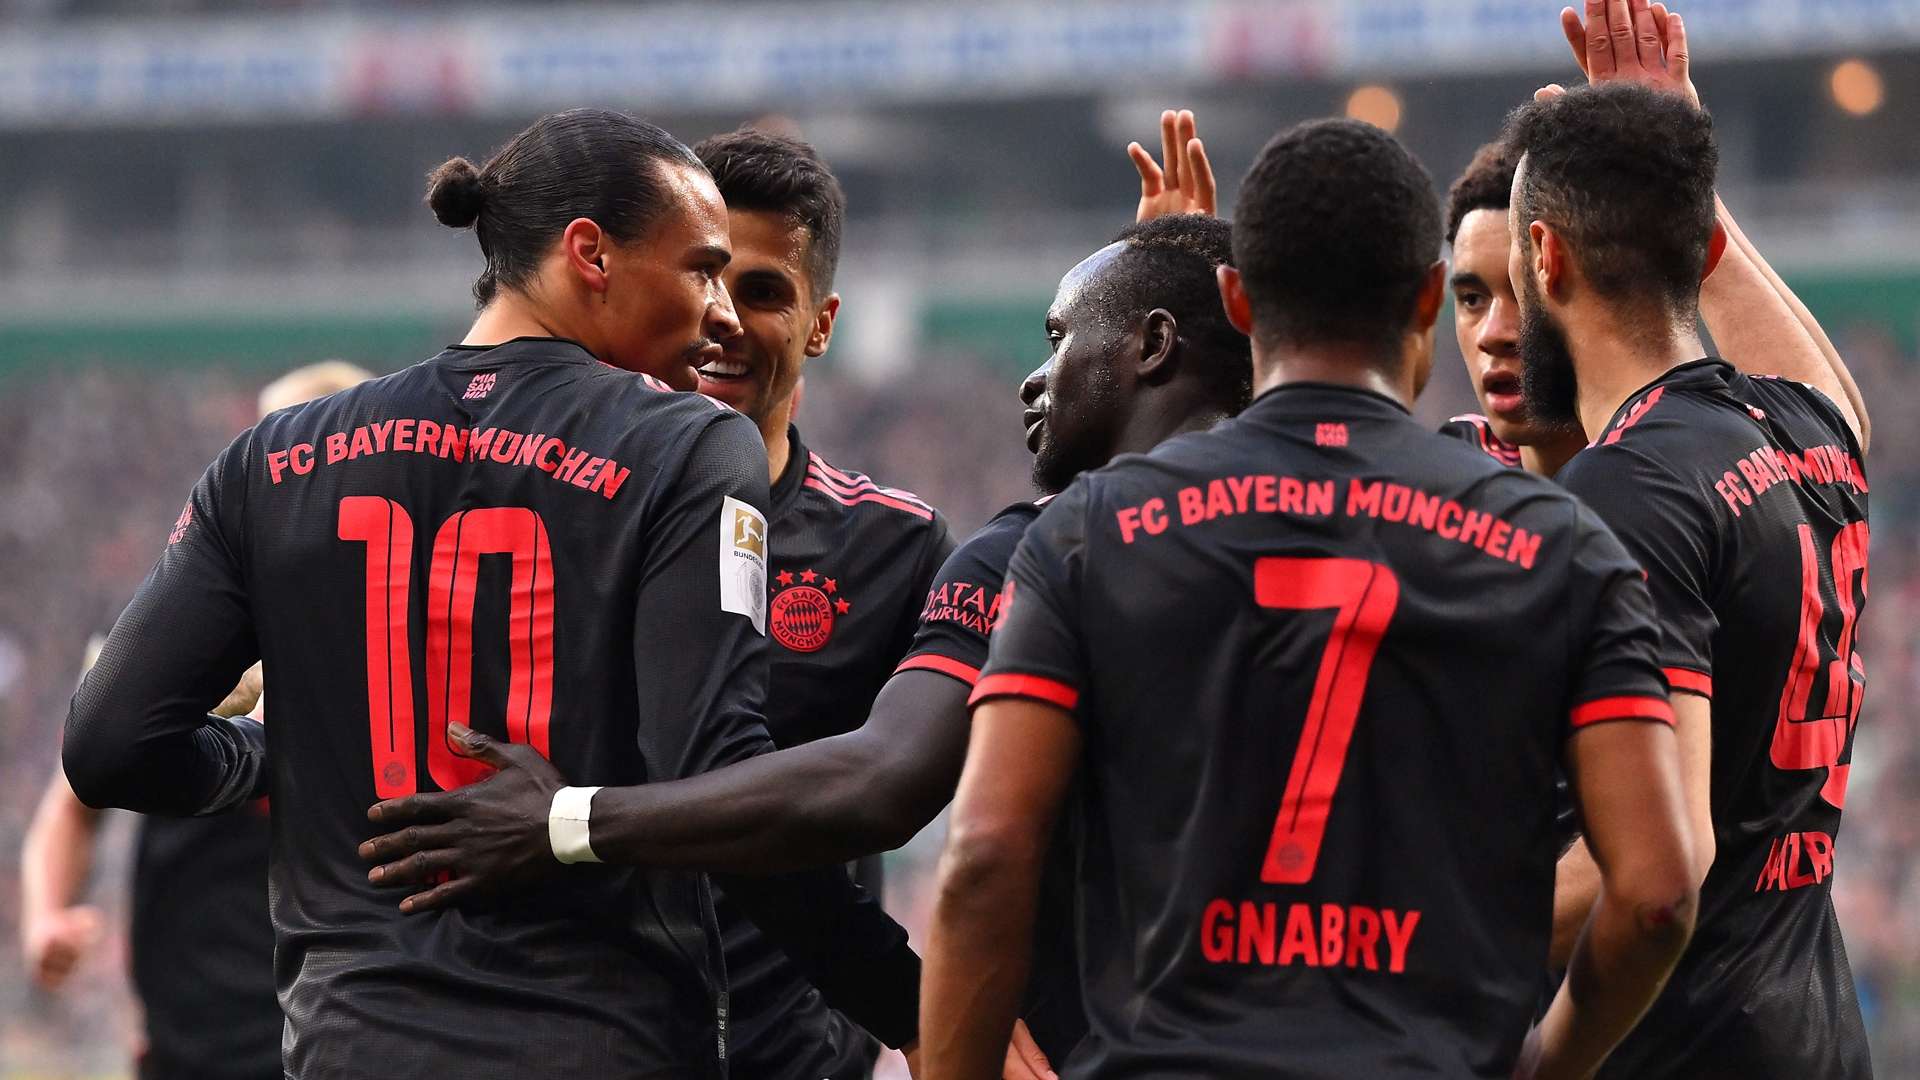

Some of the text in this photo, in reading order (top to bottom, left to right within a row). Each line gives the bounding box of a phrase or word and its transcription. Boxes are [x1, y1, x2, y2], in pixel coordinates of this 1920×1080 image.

[461, 390, 488, 400] MIA
[467, 382, 496, 392] SAN
[472, 373, 497, 383] MIA
[267, 418, 631, 500] FC BAYERN MÜNCHEN
[1116, 503, 1169, 544] FC
[1178, 475, 1336, 527] BAYERN
[1714, 471, 1753, 518] FC
[337, 495, 555, 799] 10
[1254, 557, 1400, 884] 7
[1201, 898, 1421, 973] GNABRY
